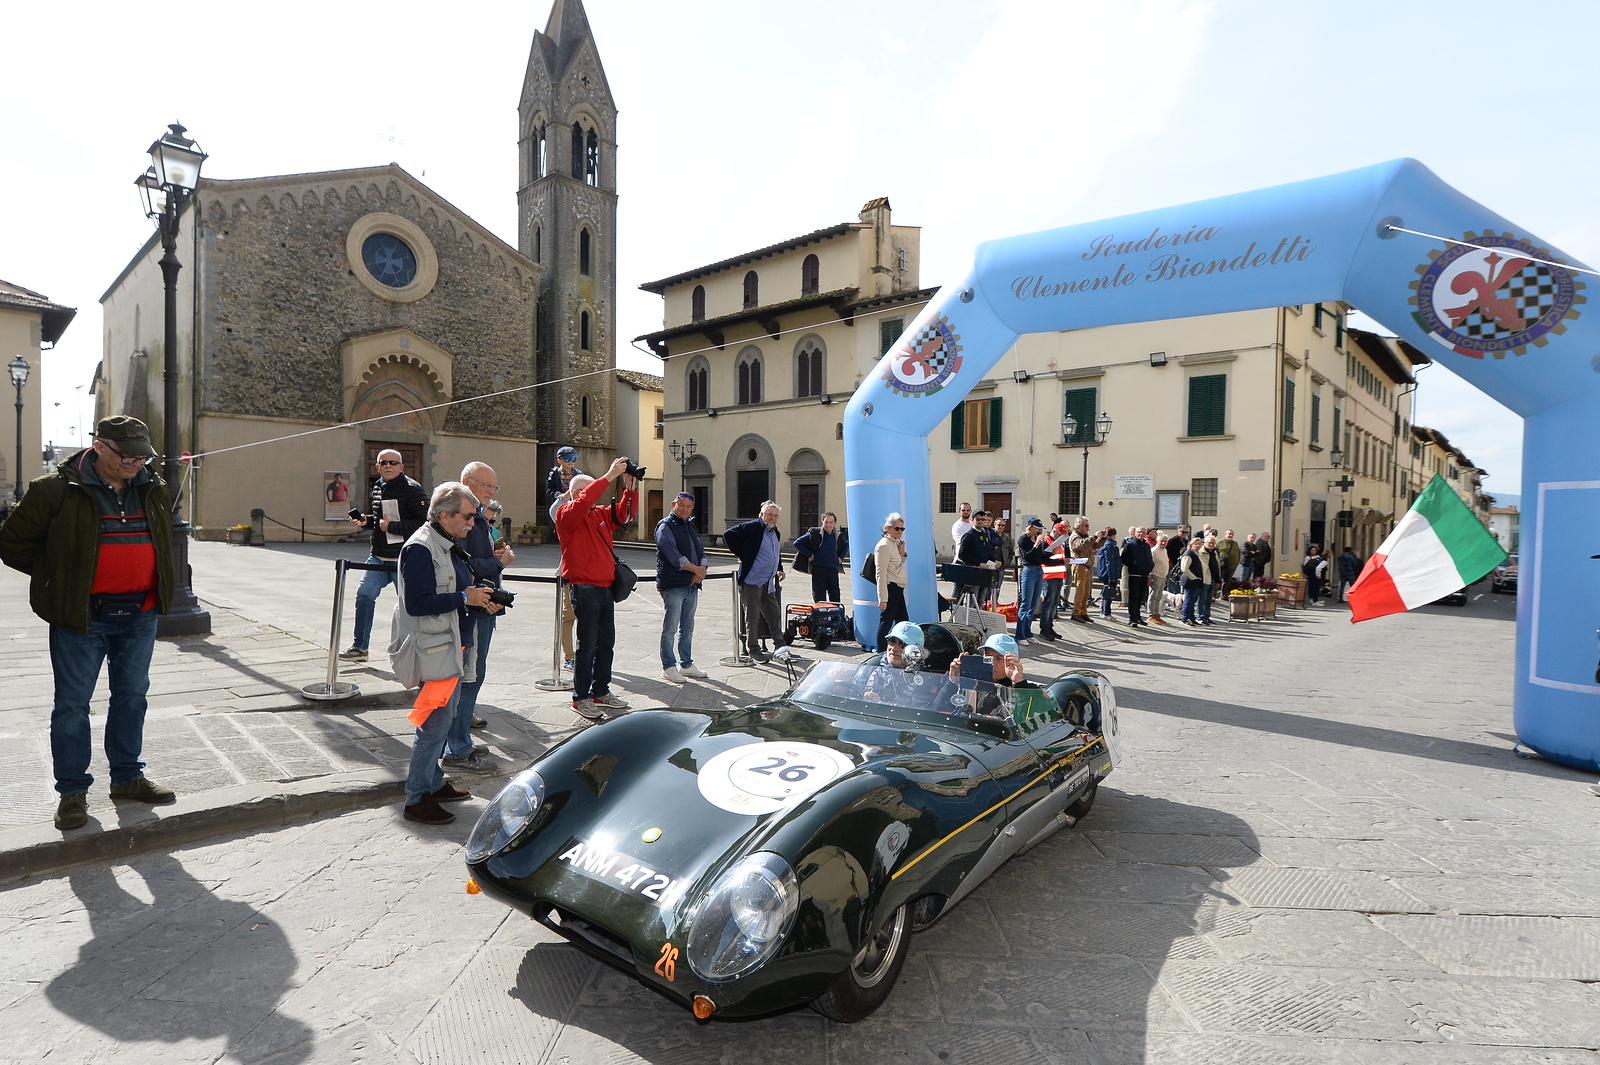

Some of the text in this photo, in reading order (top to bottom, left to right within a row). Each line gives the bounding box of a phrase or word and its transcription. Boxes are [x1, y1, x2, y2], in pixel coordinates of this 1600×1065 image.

[1082, 225, 1223, 261] Scuderia
[1011, 235, 1317, 301] Clemente Biondetti
[1512, 241, 1572, 328] AUTOOBILISTICA
[1420, 273, 1533, 351] CLEMENTE BIONDETTI
[899, 333, 956, 392] CLEMENTE BIONDETTI
[748, 757, 816, 783] 26
[557, 842, 621, 877] ANM
[655, 942, 679, 982] 26
